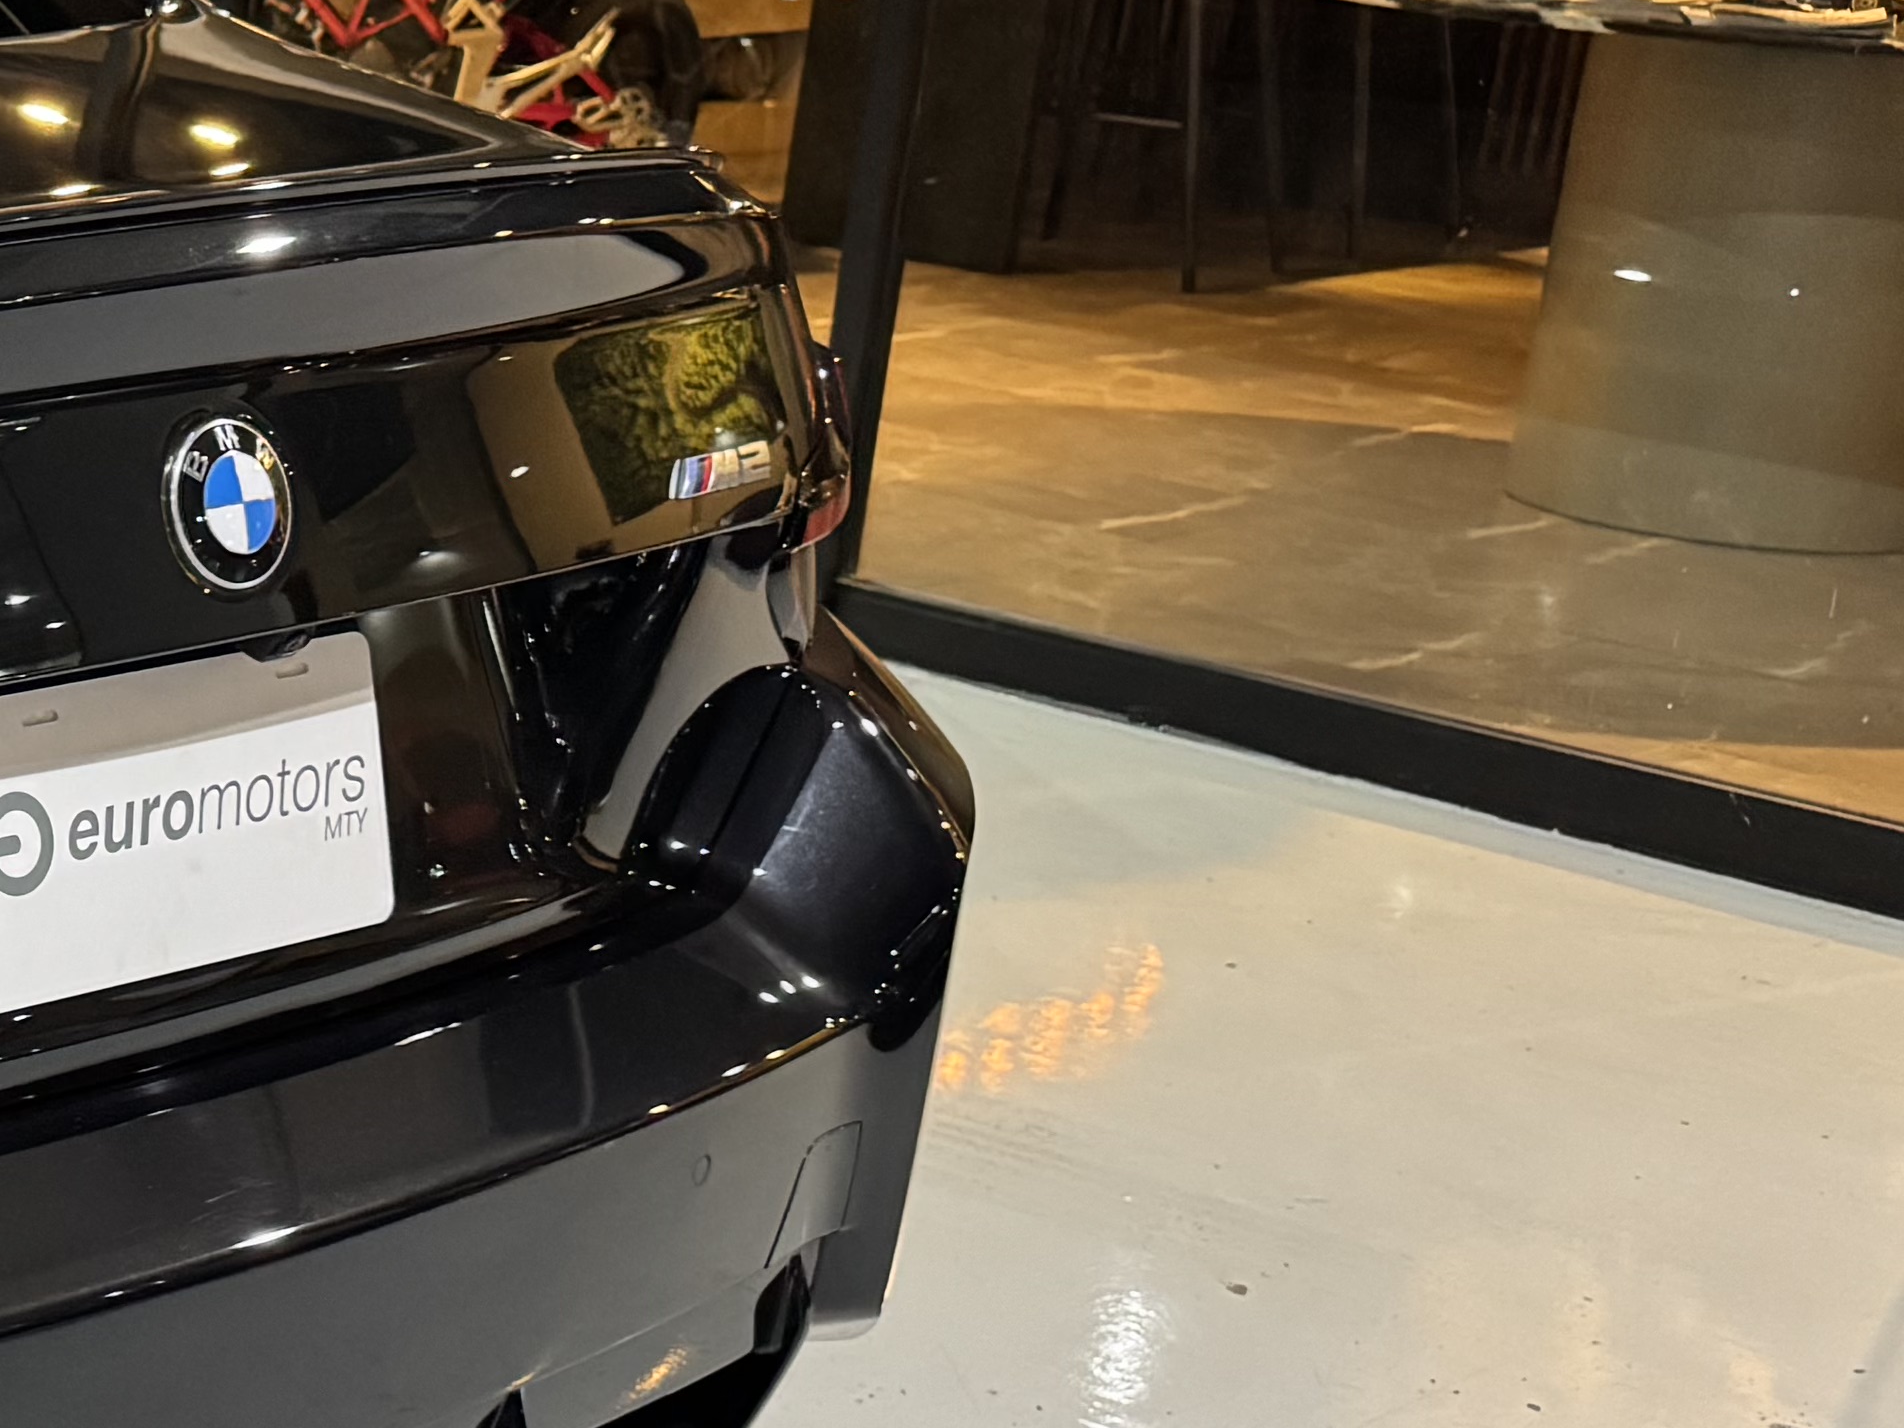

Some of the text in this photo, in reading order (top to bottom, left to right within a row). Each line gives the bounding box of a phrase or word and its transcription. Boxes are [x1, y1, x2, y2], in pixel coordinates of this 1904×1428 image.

[183, 424, 275, 482] BMW
[68, 754, 366, 861] euromotors
[323, 807, 369, 841] MTY
